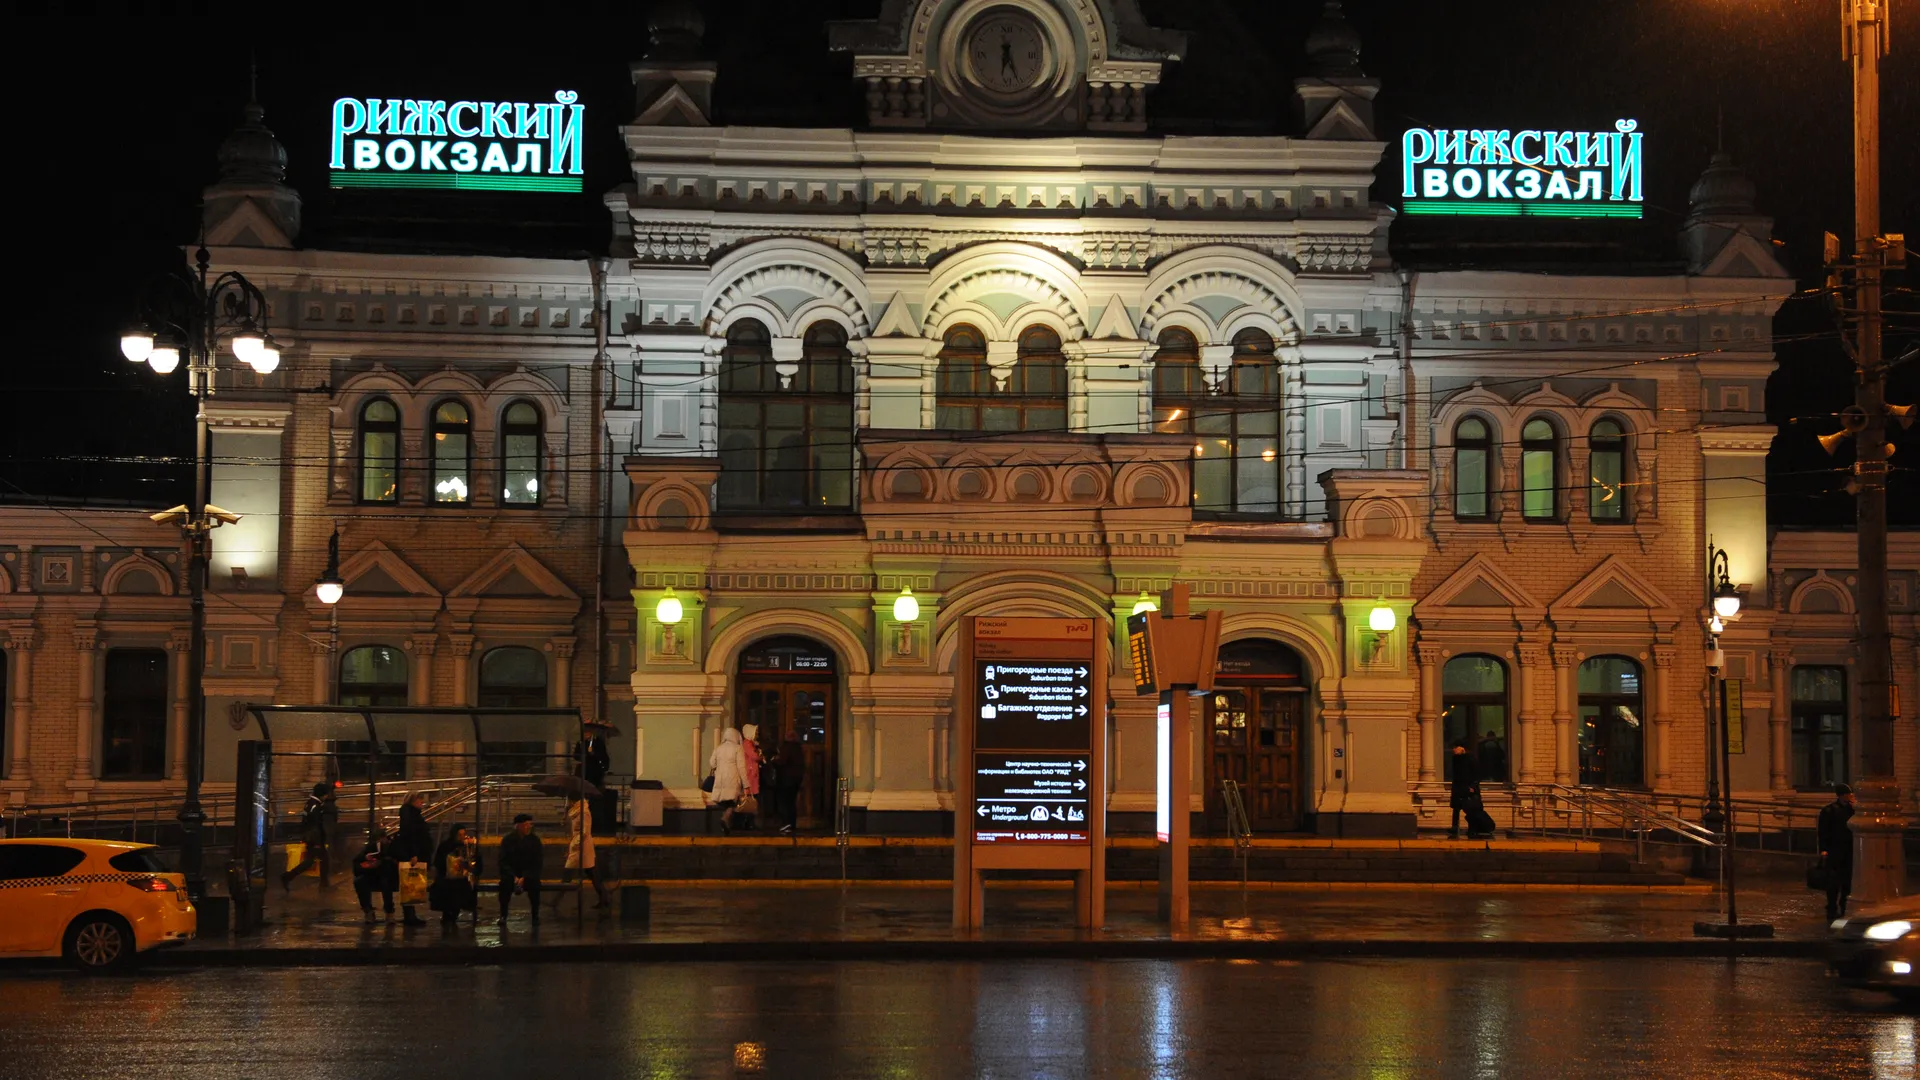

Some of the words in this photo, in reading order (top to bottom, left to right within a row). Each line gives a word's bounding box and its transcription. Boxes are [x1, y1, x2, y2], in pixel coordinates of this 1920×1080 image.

[353, 139, 542, 173] ВОКЗАЛ
[1422, 168, 1603, 200] ВОКЗАЛ
[978, 620, 1007, 628] Рижский
[997, 666, 1047, 674] Пригородные
[1001, 685, 1051, 693] Пригородные
[992, 805, 1016, 814] Метро
